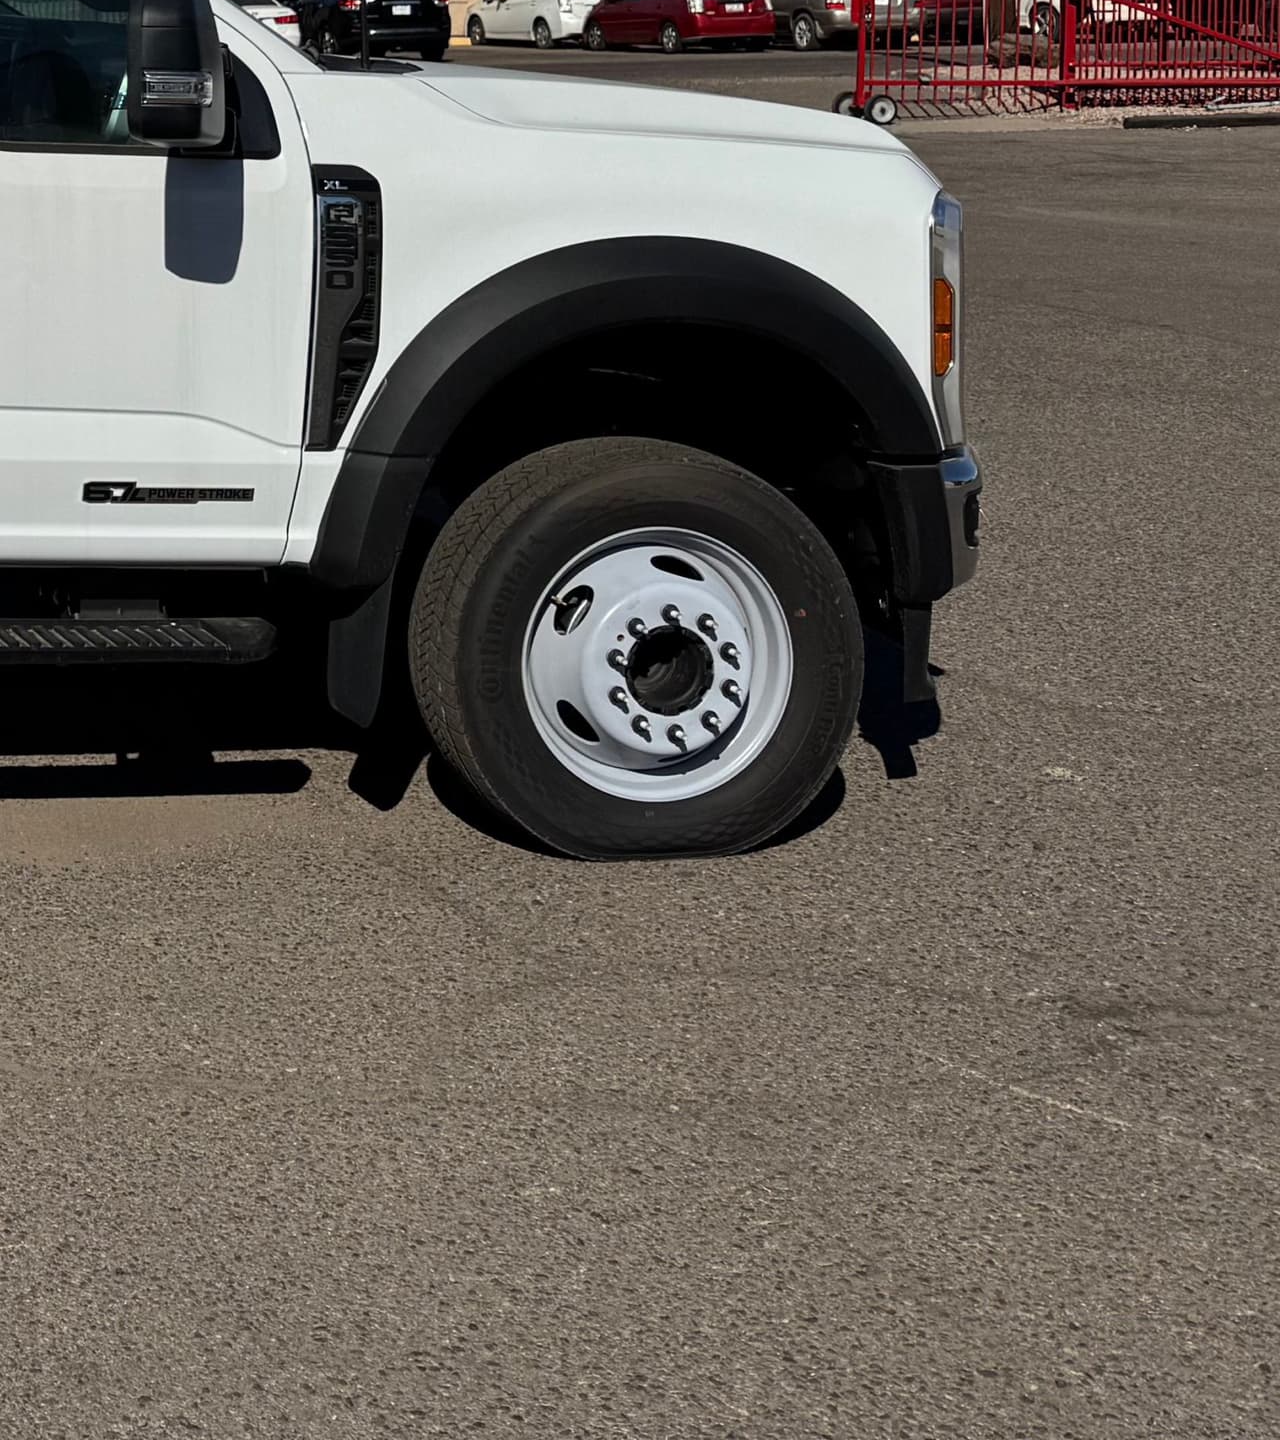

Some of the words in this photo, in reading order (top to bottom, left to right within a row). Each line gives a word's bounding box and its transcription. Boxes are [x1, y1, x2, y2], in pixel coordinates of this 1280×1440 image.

[323, 180, 348, 191] XL
[148, 488, 195, 500] POWER
[198, 488, 252, 500] STROKE
